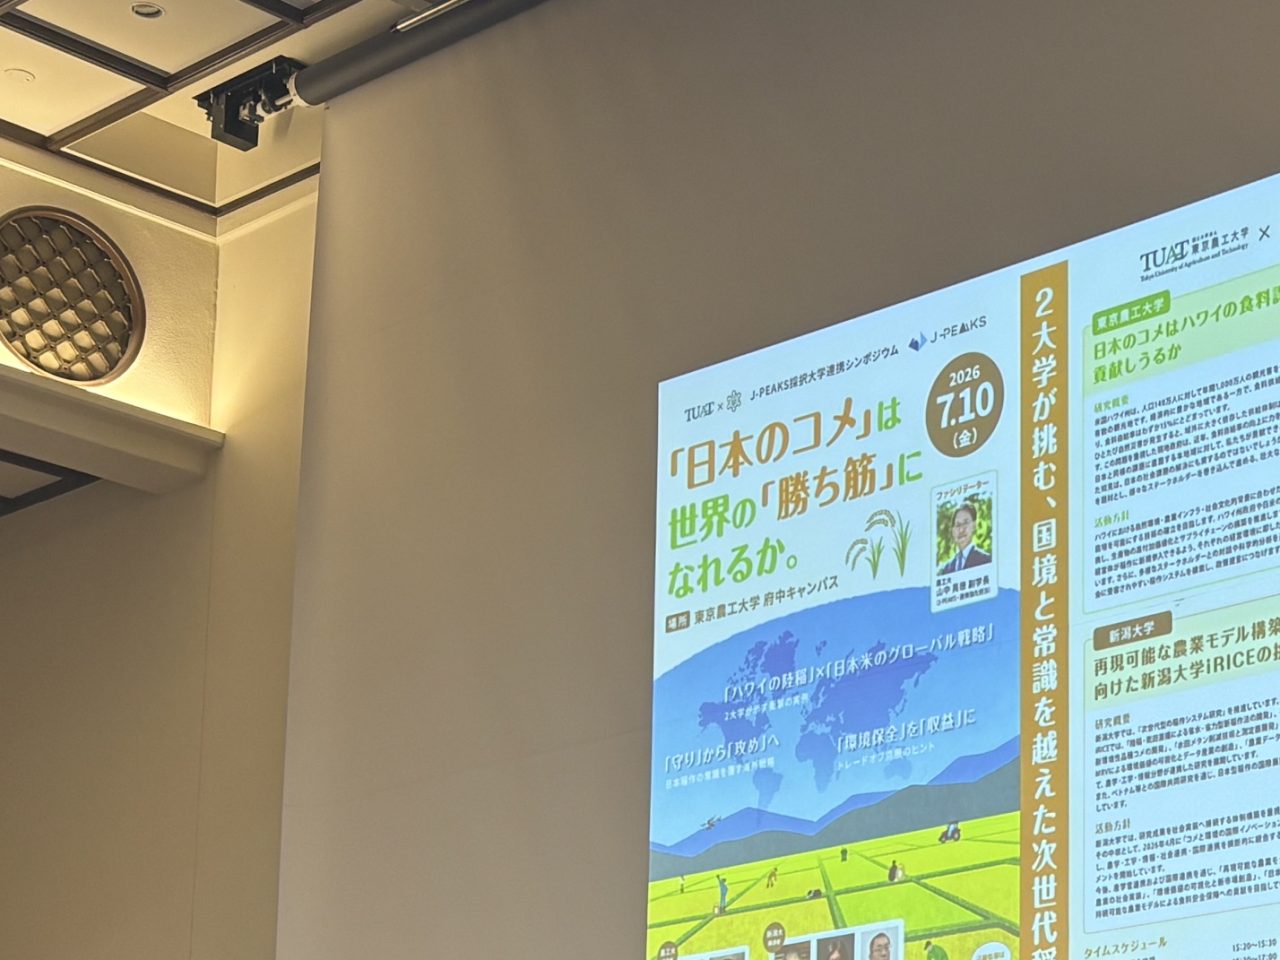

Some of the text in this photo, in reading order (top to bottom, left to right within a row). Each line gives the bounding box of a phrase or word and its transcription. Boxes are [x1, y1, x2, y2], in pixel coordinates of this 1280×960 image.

[1139, 238, 1189, 273] TUAT
[1191, 225, 1249, 256] 東京農工大学
[929, 313, 987, 344] J-PEAKS
[1096, 295, 1165, 331] 東京農工大学
[749, 341, 899, 403] J-PEAKS採択大学連携シンポジウム
[948, 363, 980, 388] 2026
[1092, 339, 1182, 386] 貢献しうるか
[683, 399, 715, 424] TUAT
[935, 378, 994, 431] 7.10
[669, 377, 902, 497] 「日本のコメ」は
[667, 432, 923, 553] 世界の「勝ち筋」に
[936, 476, 989, 501] ファシリテーター
[667, 527, 798, 603] なれるか。
[693, 572, 839, 626] 東京農工大学 府中キャンパス
[1108, 618, 1155, 644] 新潟大学
[837, 706, 976, 755] 「環境保全」を「収益」に
[664, 729, 780, 773] 「守り」から「攻め」へ
[1083, 935, 1168, 960] タイムスケジュール
